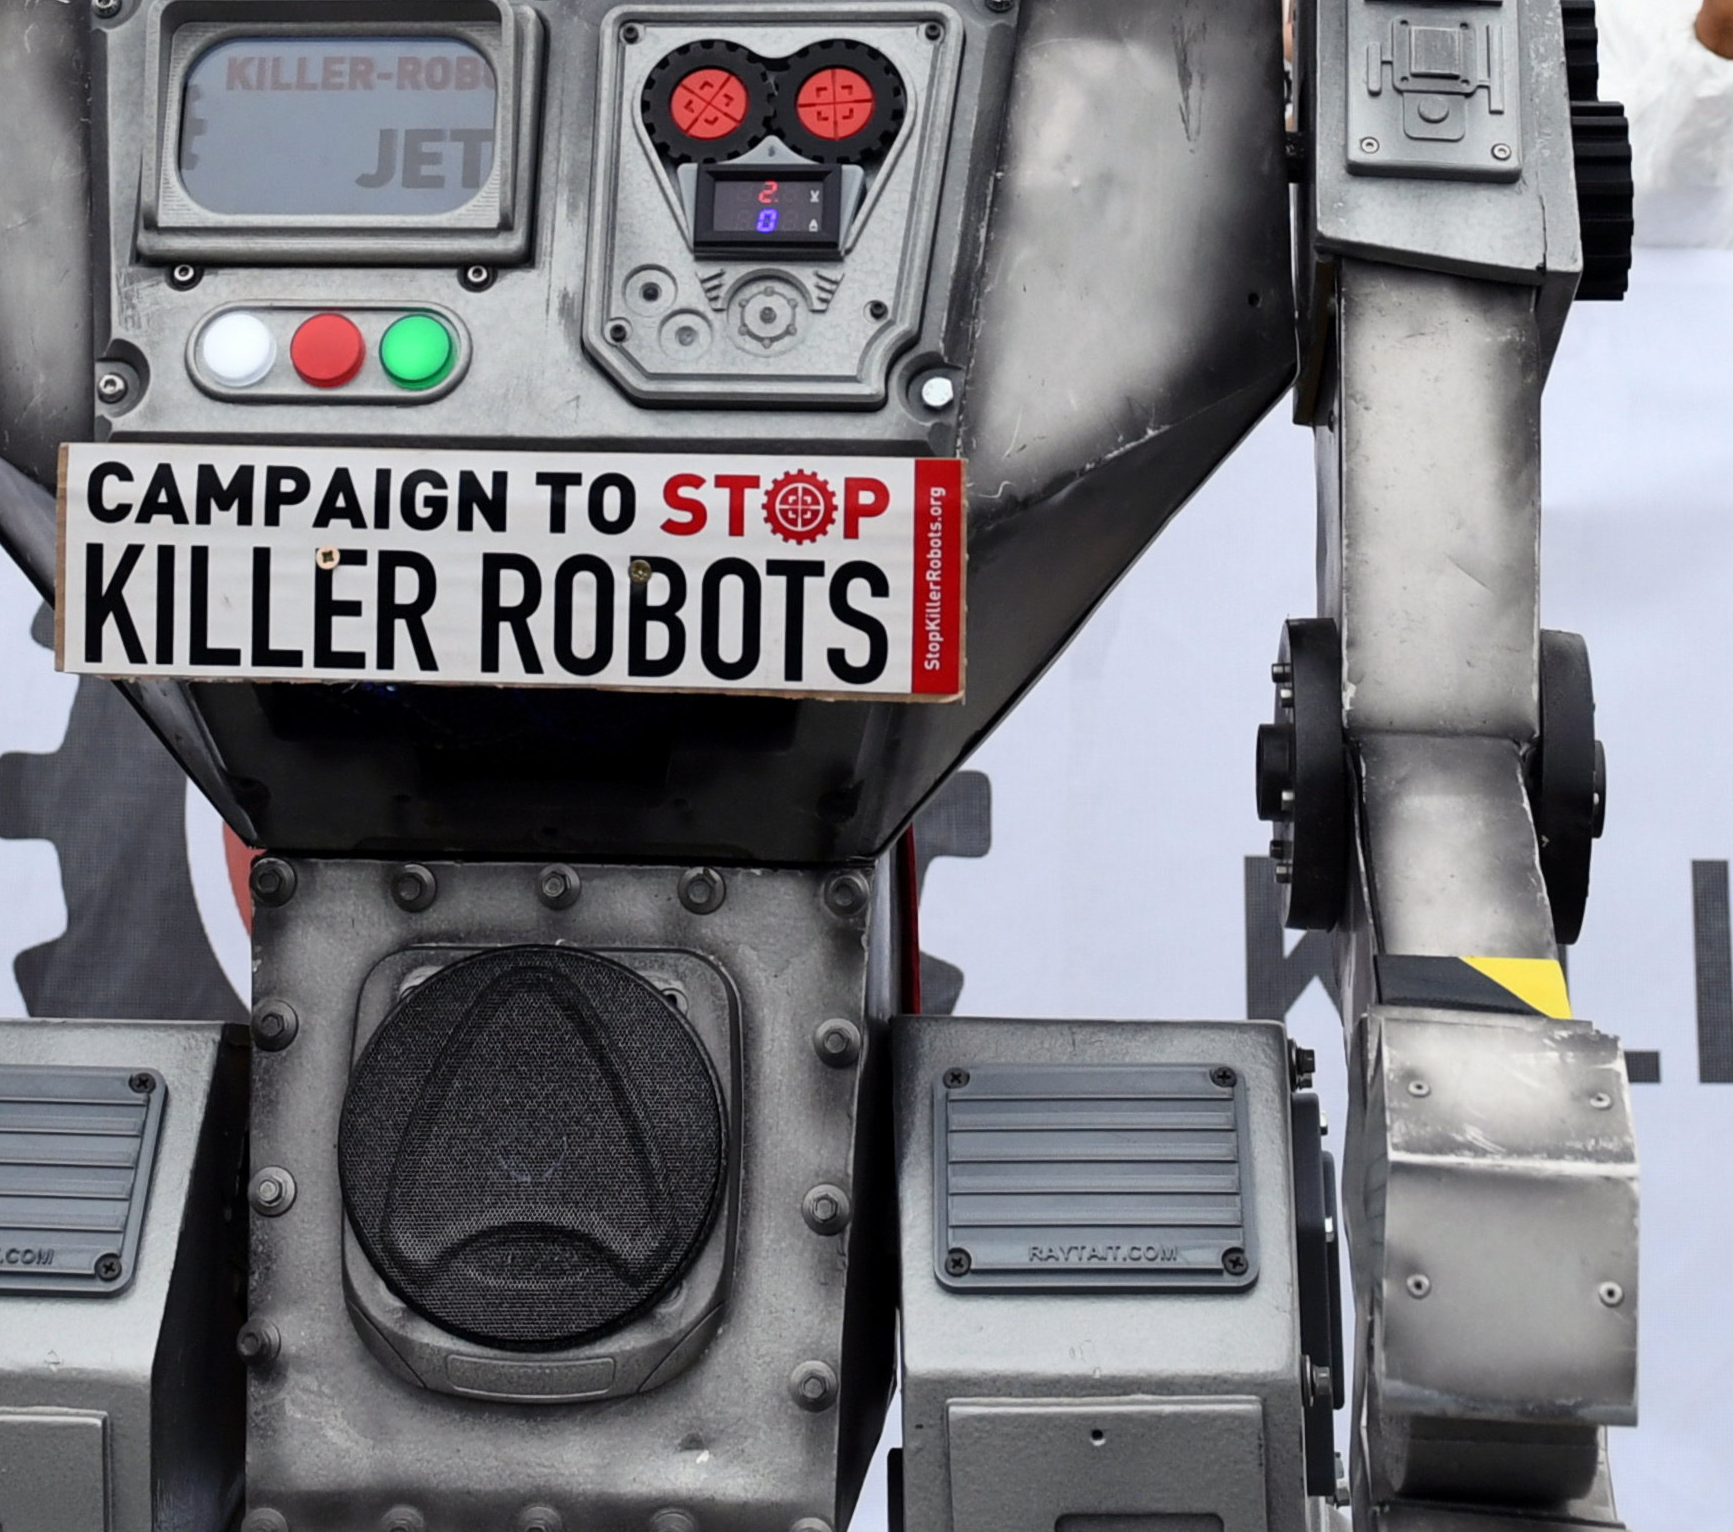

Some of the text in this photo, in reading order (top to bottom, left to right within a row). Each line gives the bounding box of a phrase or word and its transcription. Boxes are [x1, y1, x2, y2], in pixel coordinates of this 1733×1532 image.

[756, 208, 778, 233] 0
[86, 461, 890, 545] CAMPAIGN TO STOP
[83, 542, 890, 685] KILLER ROBOTS
[924, 486, 947, 671] StopKillerRobots.org
[1028, 1245, 1178, 1262] RAYTAIT.COM
